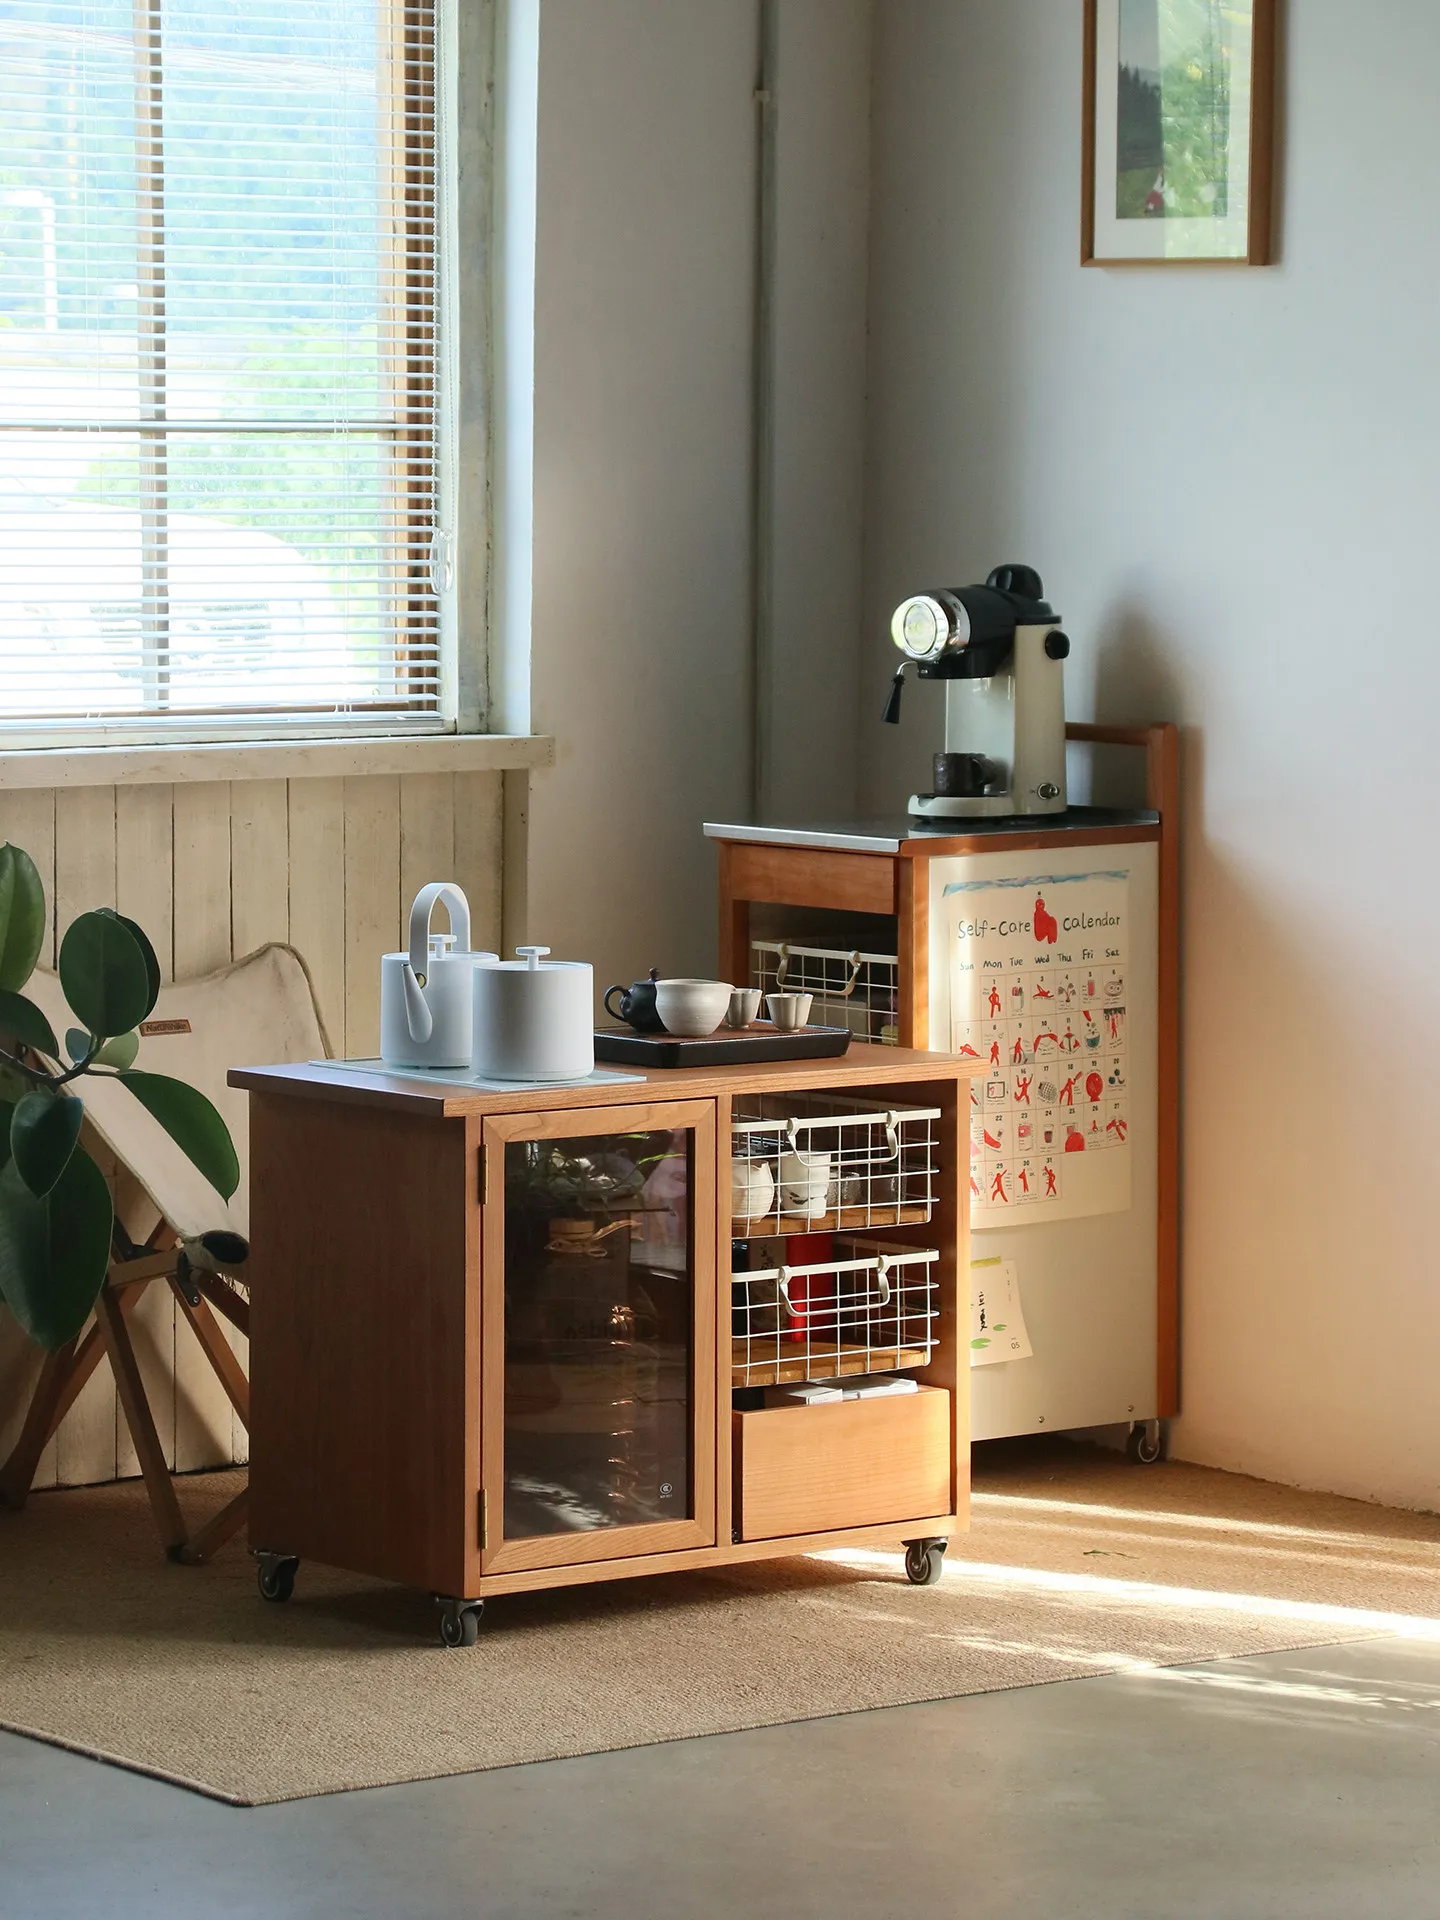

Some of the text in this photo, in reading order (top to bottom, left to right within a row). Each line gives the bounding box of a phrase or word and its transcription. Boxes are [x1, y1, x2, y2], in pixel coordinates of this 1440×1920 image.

[960, 948, 1120, 971] Sun Mon Tue Wed Thu Fri Sat
